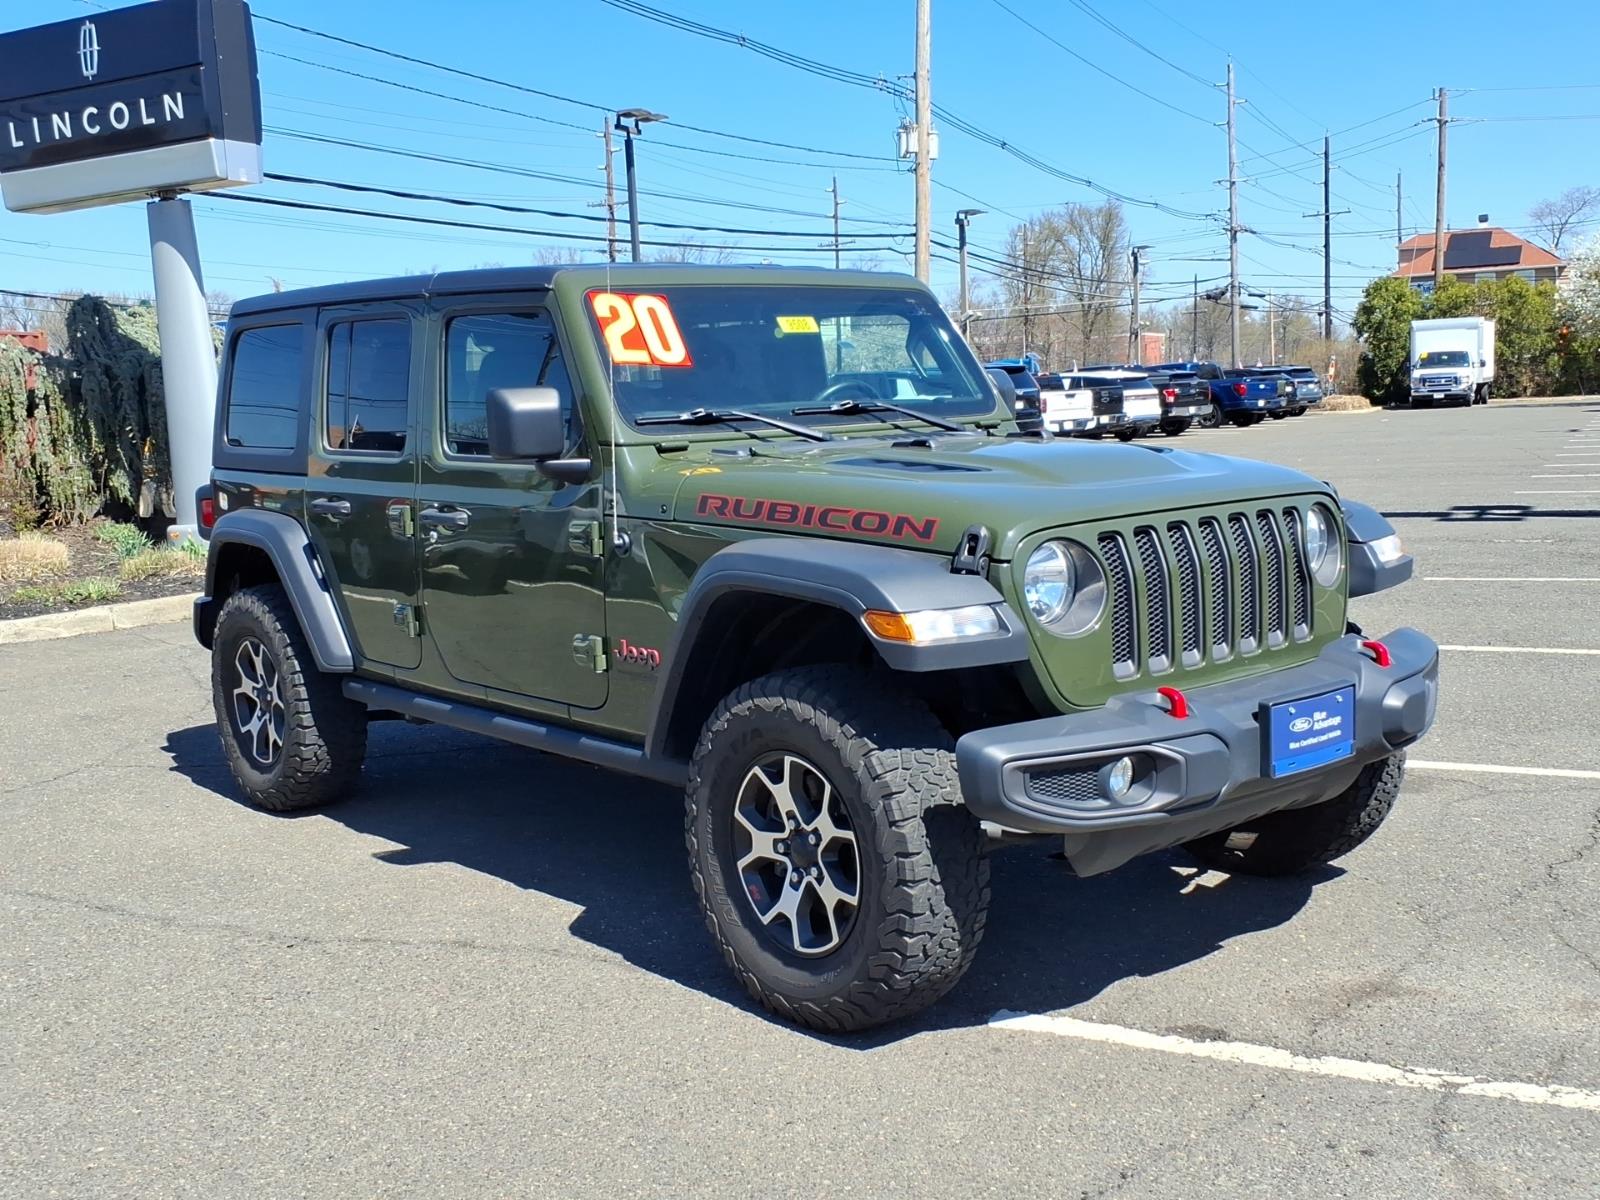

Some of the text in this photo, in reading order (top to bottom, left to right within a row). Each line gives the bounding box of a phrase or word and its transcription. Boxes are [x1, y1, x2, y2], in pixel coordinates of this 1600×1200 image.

[9, 92, 185, 148] LINCOLN
[593, 293, 686, 364] 20
[697, 494, 939, 542] RUBICON
[613, 639, 661, 671] Jeep
